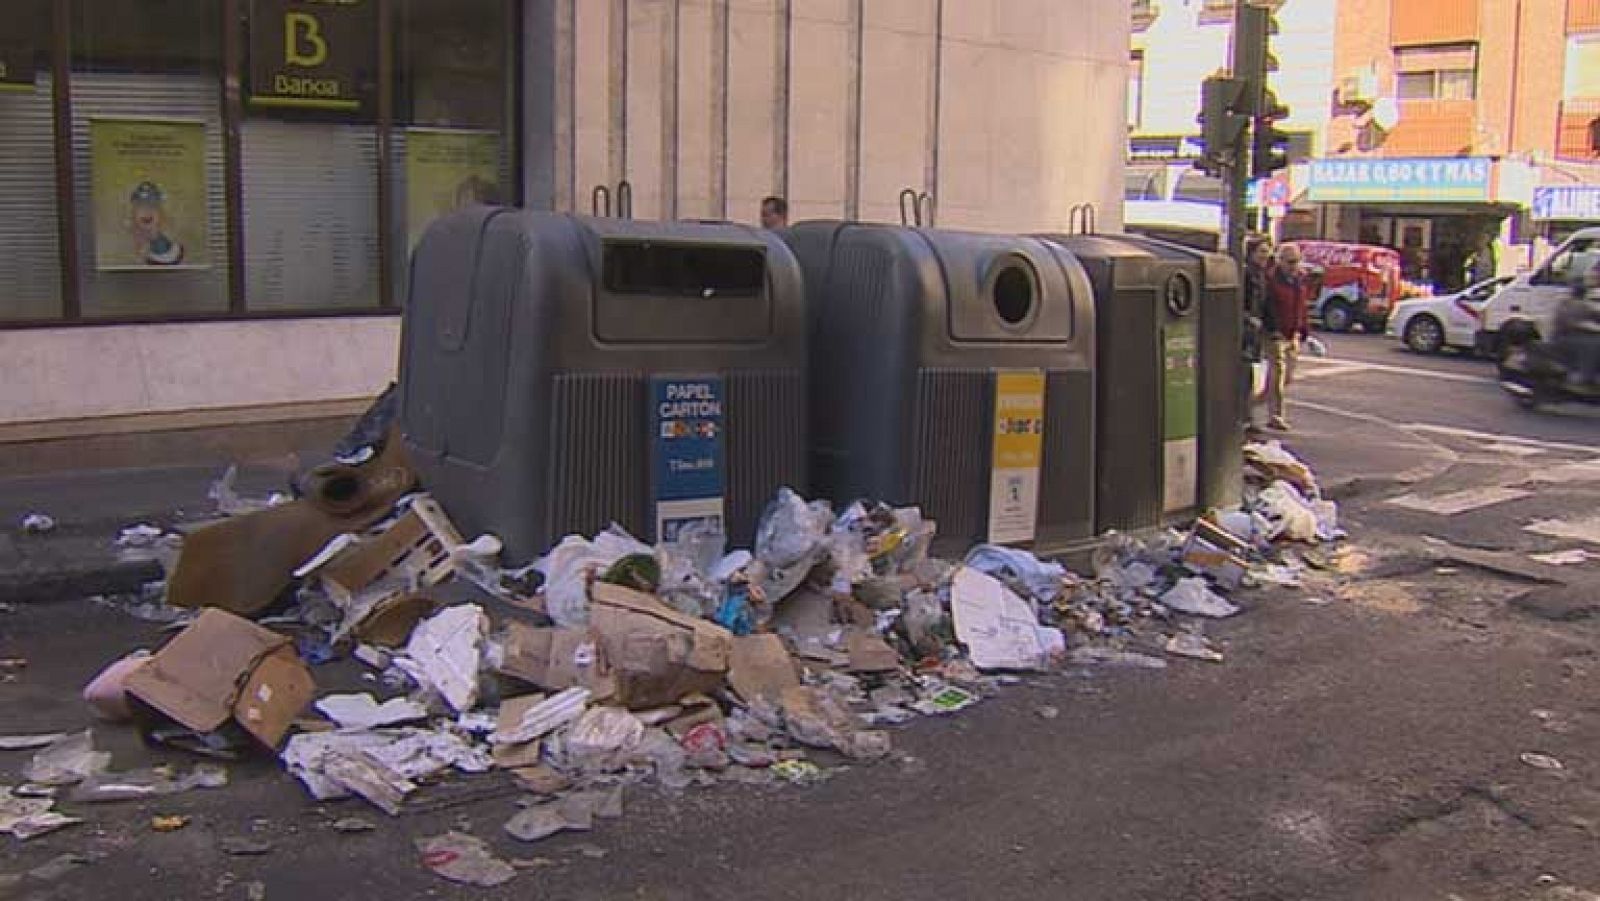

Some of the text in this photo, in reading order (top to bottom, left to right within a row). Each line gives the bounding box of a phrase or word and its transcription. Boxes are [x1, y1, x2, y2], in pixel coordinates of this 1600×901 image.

[285, 12, 327, 66] B
[275, 75, 338, 95] Bankia
[1313, 162, 1369, 182] BAZAR
[665, 384, 716, 400] PAPEL
